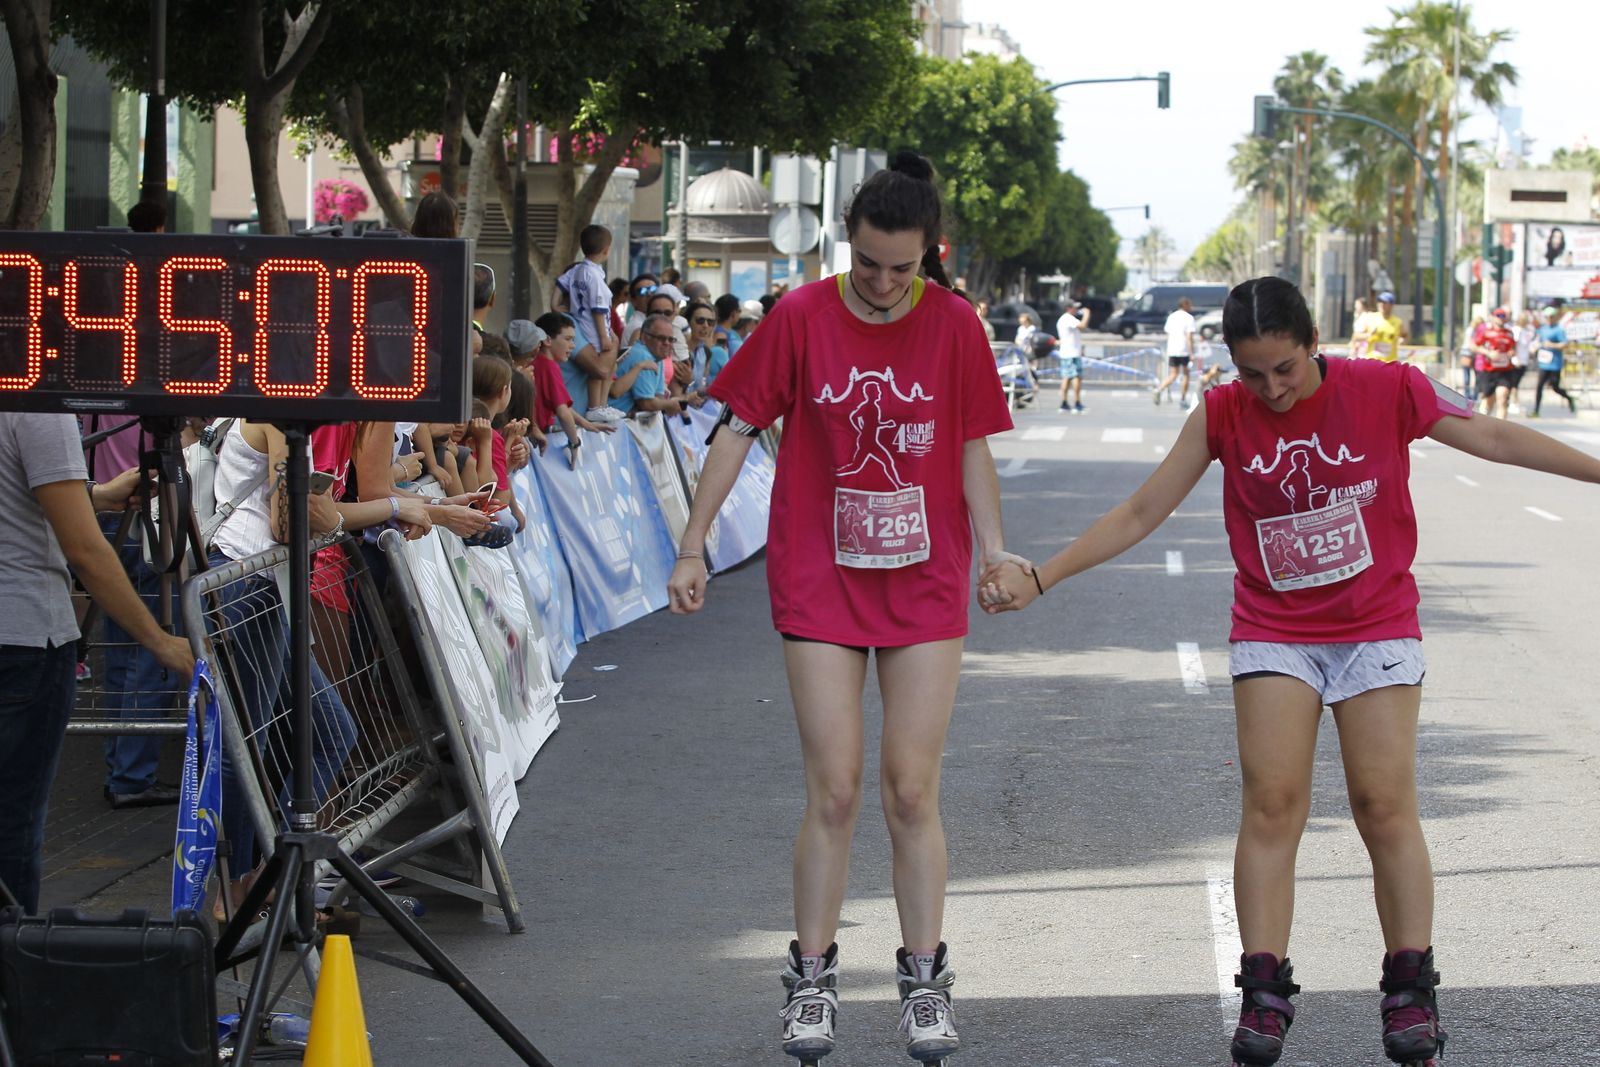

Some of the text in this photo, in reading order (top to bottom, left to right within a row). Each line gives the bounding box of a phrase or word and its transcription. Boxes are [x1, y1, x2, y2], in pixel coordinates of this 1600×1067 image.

[1337, 478, 1378, 498] CARRERA
[862, 511, 922, 538] 1262
[882, 538, 905, 547] FELICES
[1293, 522, 1357, 557] 1257
